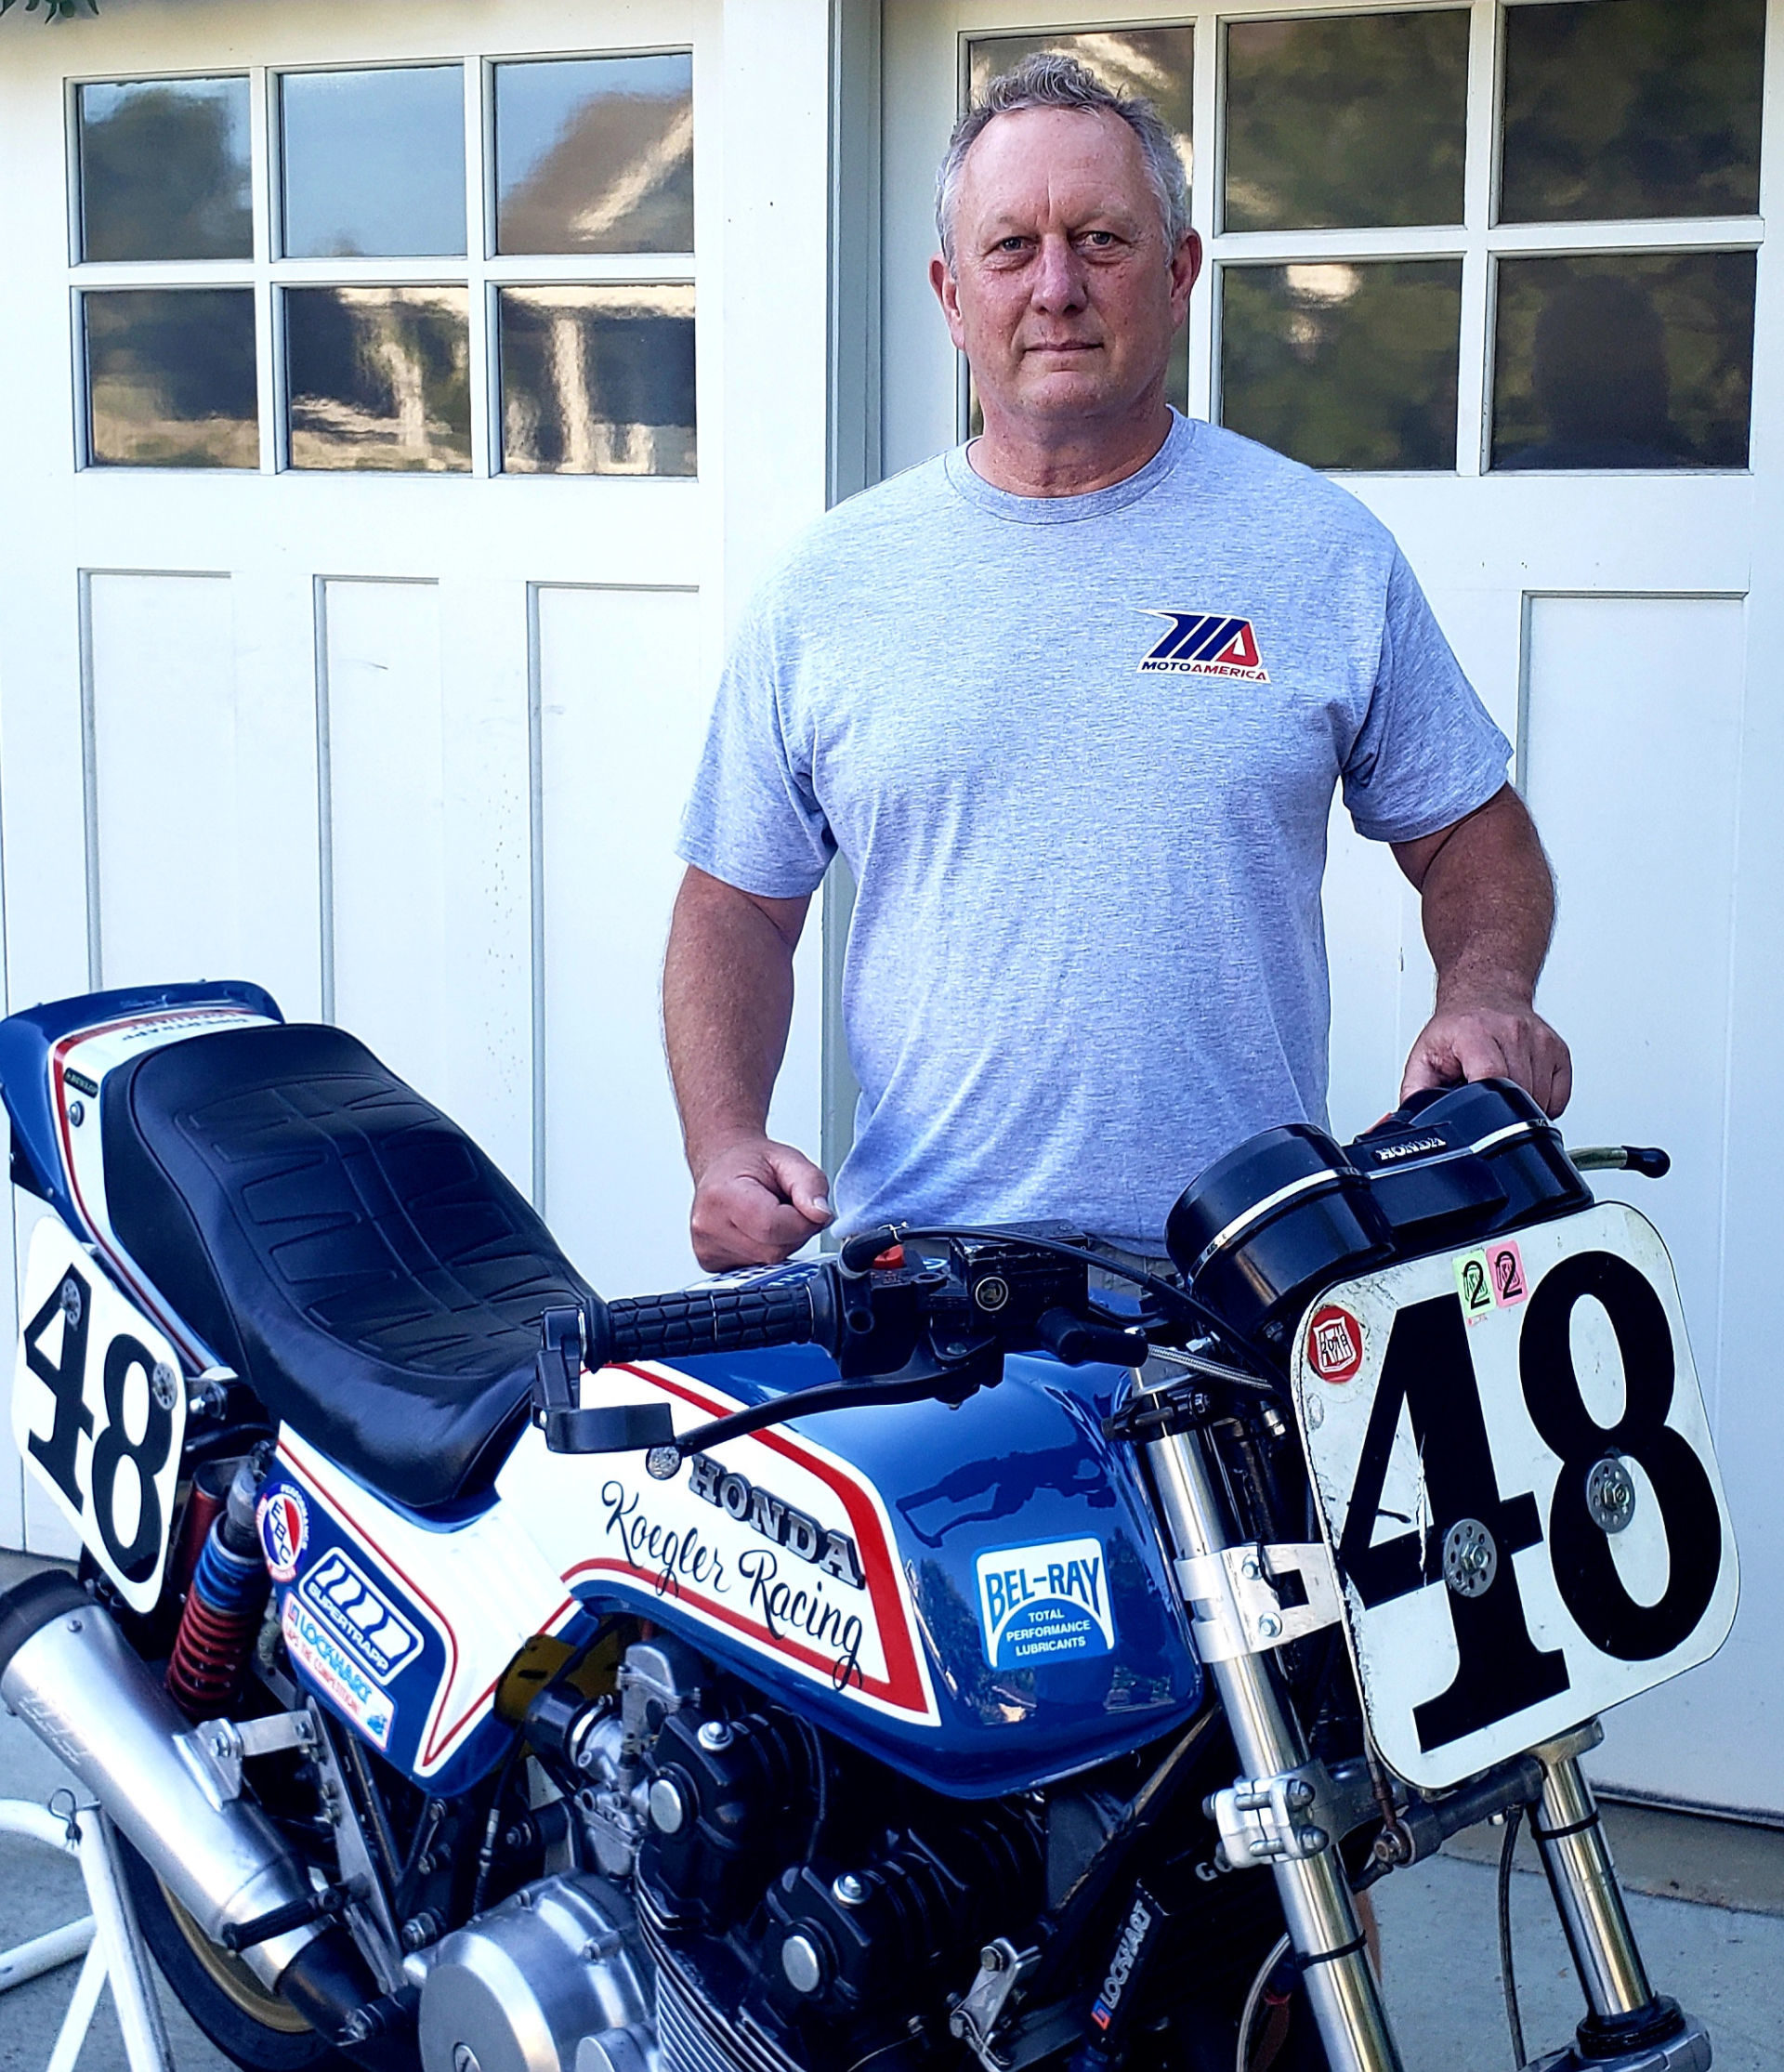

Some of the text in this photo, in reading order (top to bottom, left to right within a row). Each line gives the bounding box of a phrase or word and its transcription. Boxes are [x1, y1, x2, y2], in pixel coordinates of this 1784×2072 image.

[1141, 661, 1267, 681] MOTOAMERICA
[1374, 1136, 1447, 1161] HONDA
[23, 1263, 173, 1583] 48
[270, 1499, 292, 1565] EBC
[689, 1450, 866, 1590] HONDA
[1337, 1250, 1723, 1754] 48
[601, 1480, 864, 1692] Koegler Racing
[984, 1556, 1102, 1634] BEL-RAY
[1028, 1608, 1065, 1623] TOTAL
[308, 1580, 389, 1671] SUPERTRAPP
[1006, 1620, 1092, 1642] PERFORMANCE
[1015, 1635, 1086, 1657] LUBRICANTS
[1099, 1898, 1152, 2010] LOCKHART
